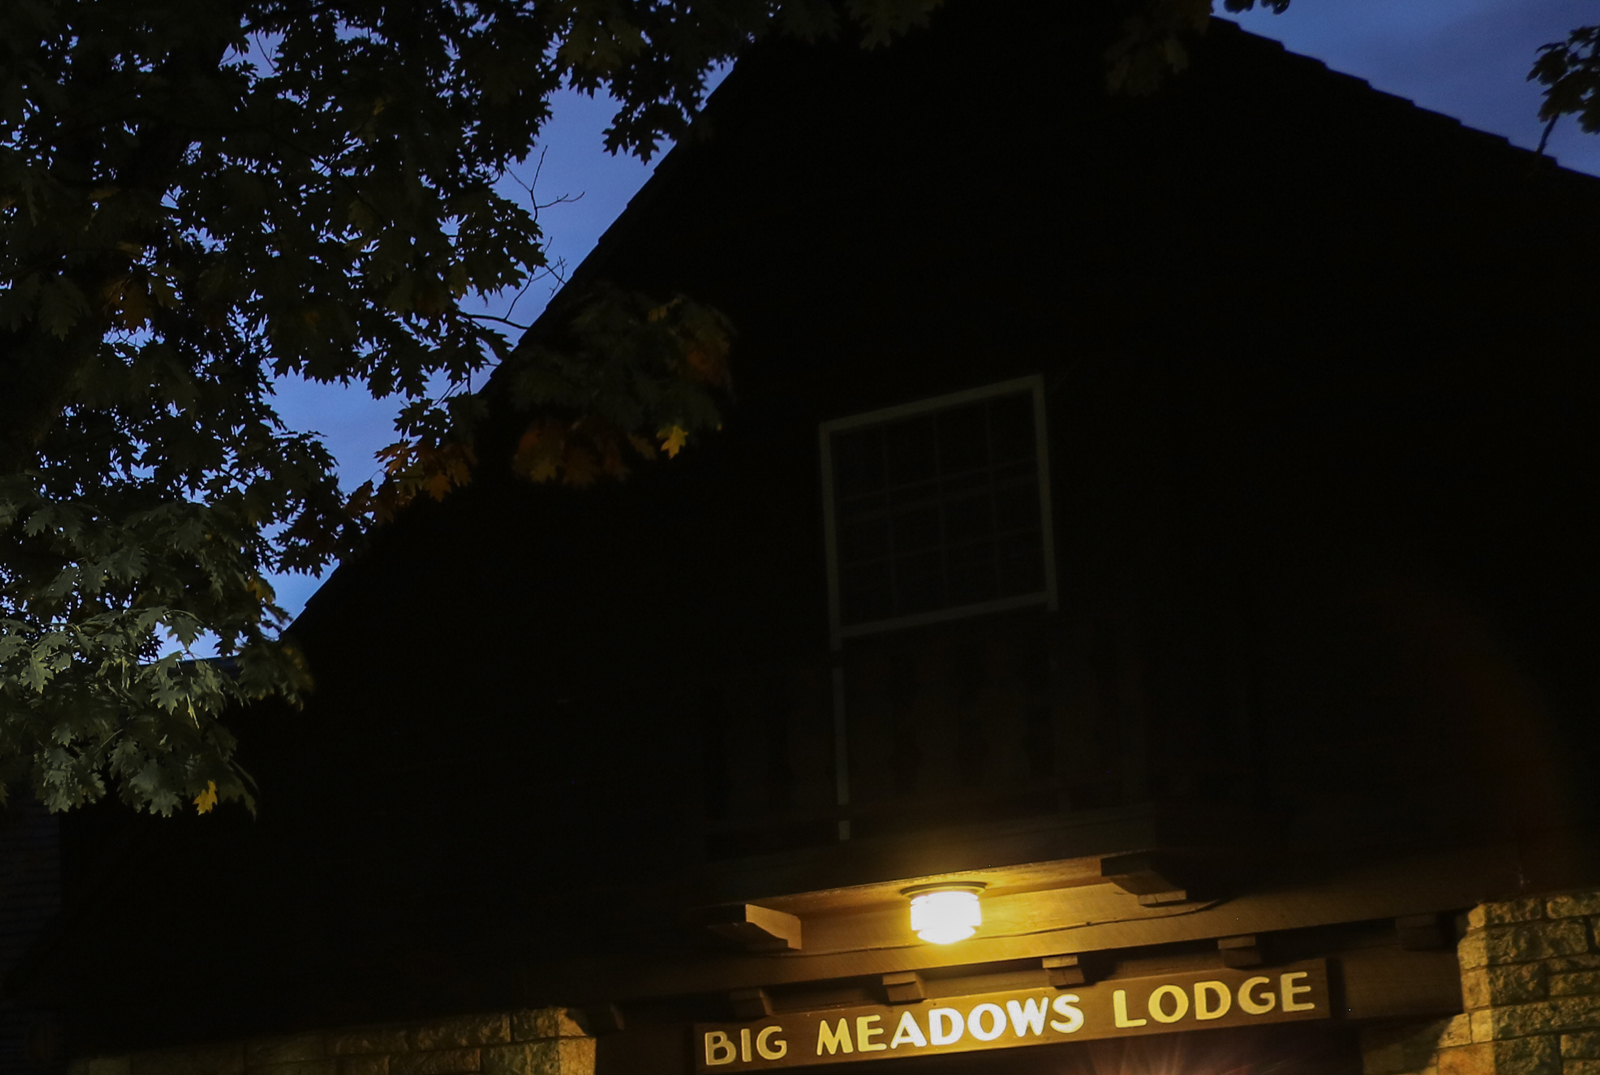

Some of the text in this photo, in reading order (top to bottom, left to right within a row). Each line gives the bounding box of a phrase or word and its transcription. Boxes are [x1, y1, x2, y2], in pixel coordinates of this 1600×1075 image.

[704, 971, 1315, 1066] BIG MEADOWS LODGE
